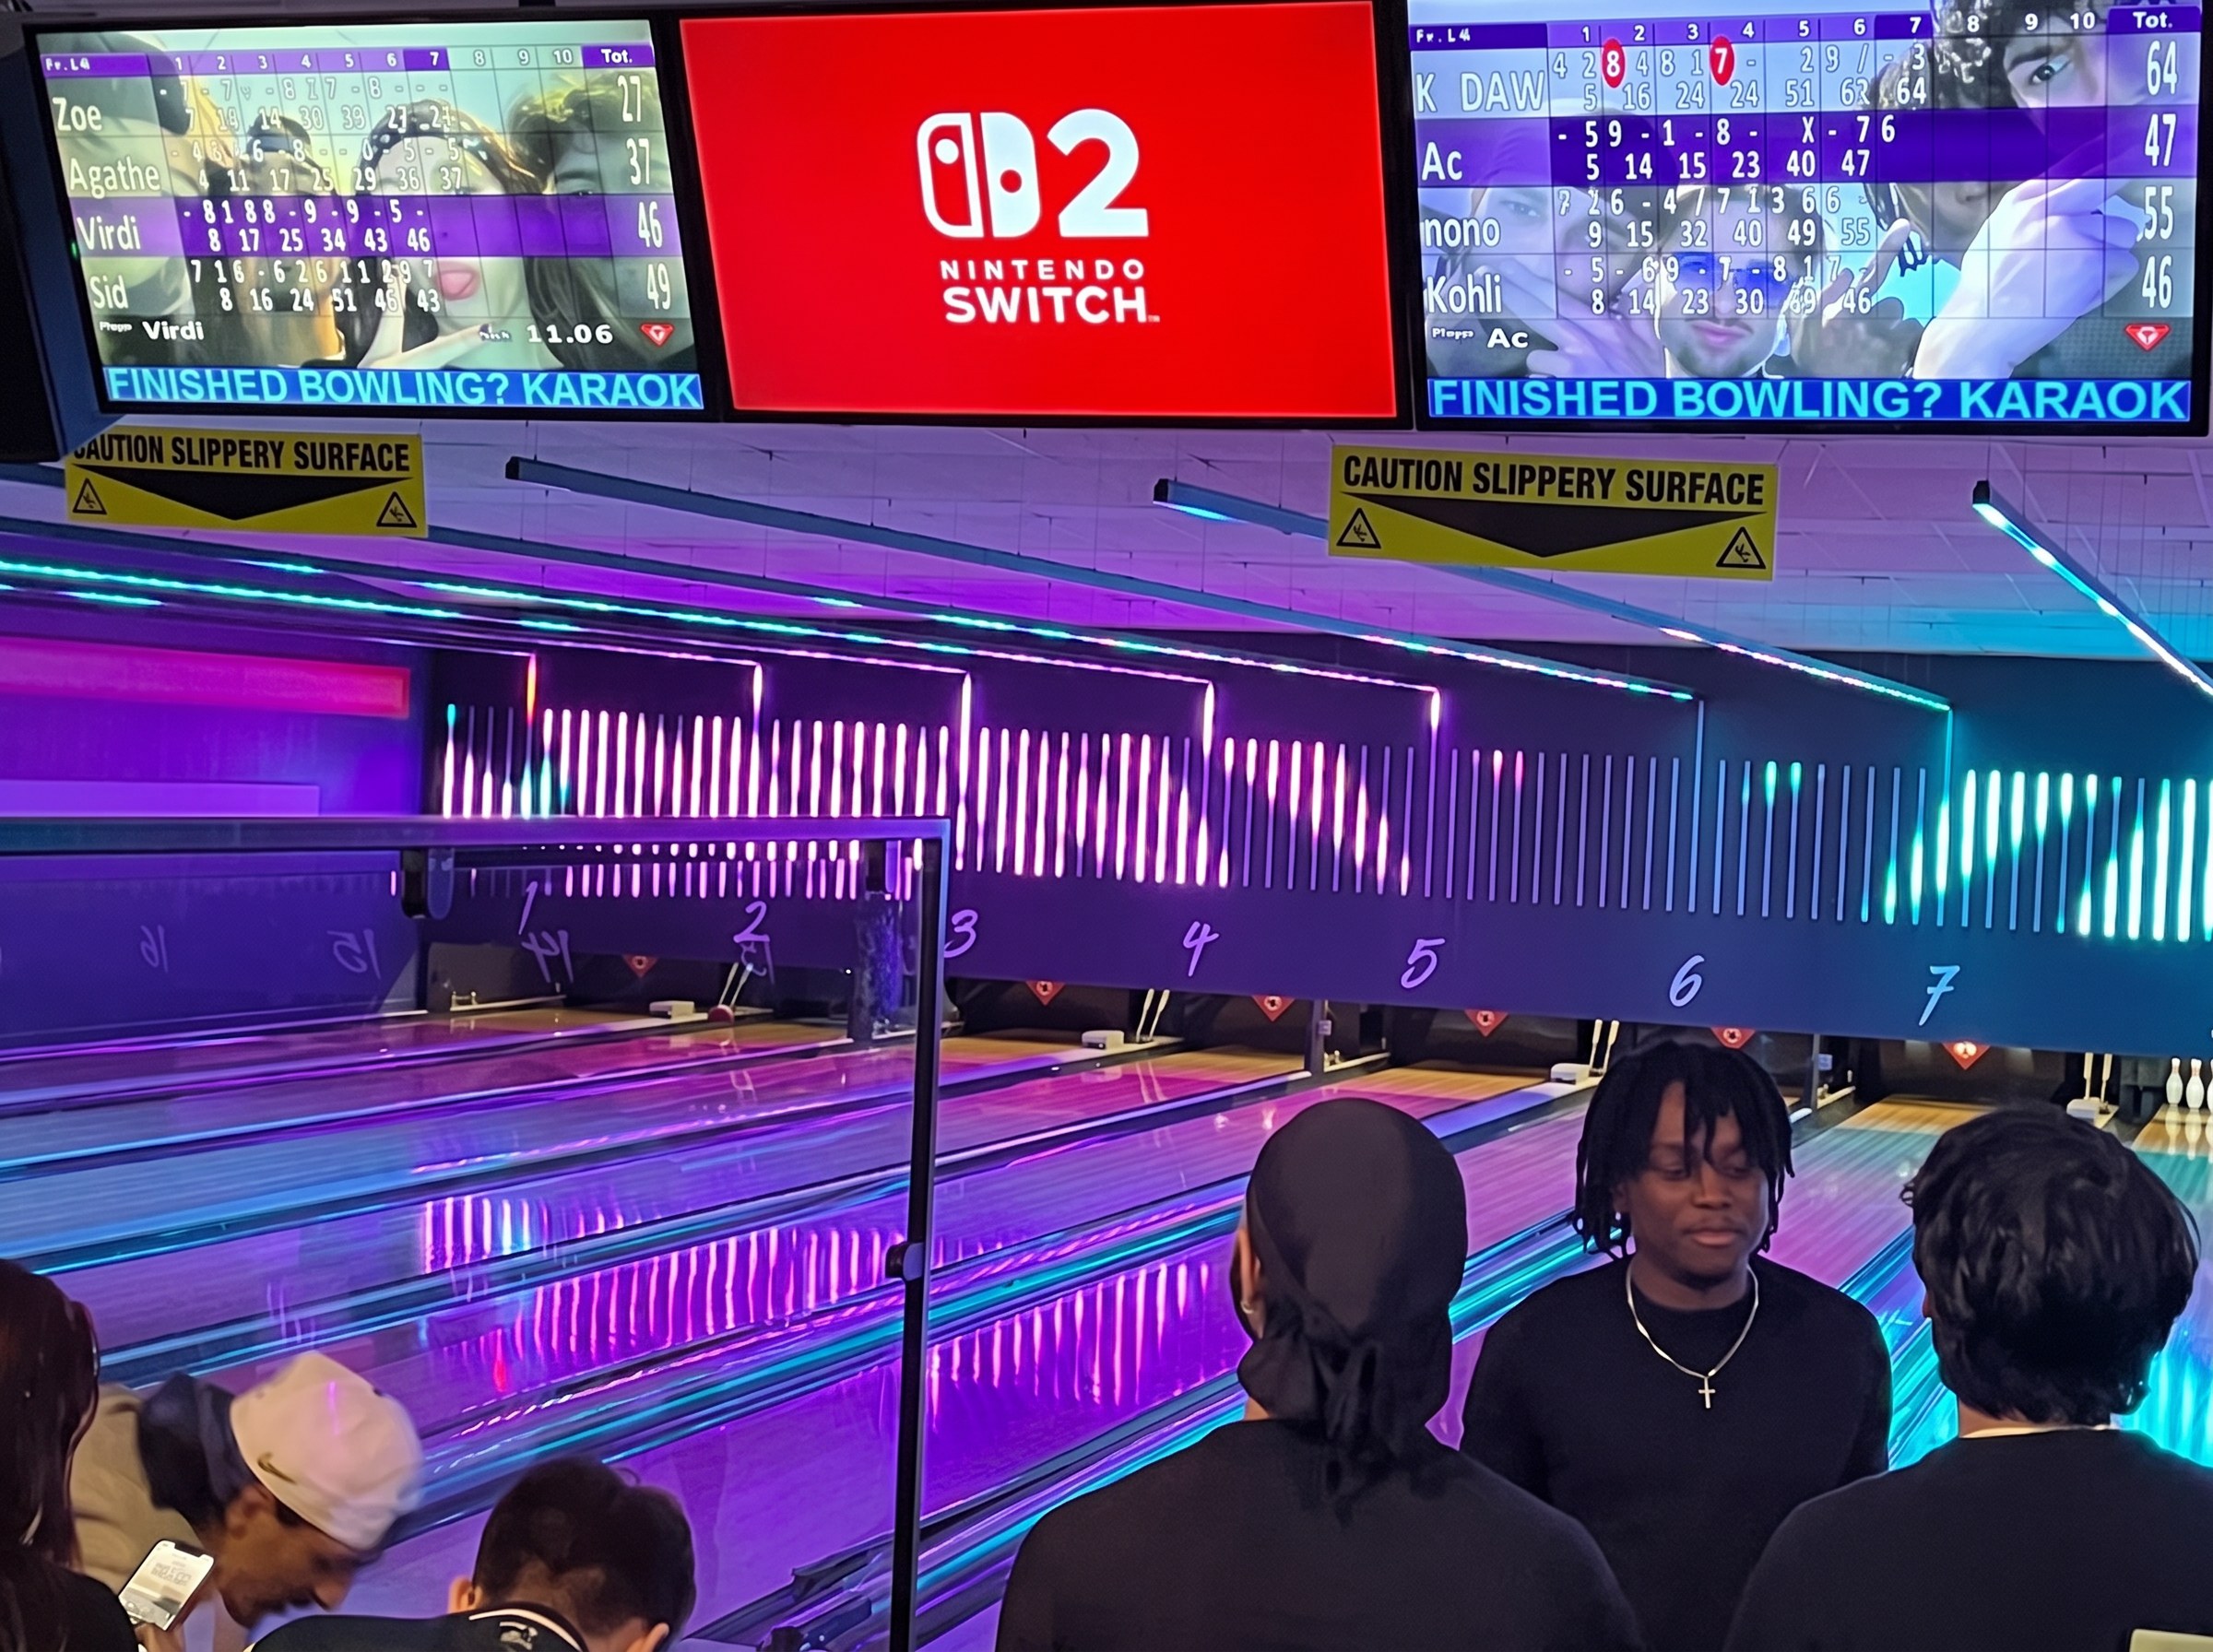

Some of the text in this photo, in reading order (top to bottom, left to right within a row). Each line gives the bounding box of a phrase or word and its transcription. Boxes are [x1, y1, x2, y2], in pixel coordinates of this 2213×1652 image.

[1582, 26, 1591, 42] 1
[1634, 25, 1645, 41] 2
[1687, 24, 1698, 40] 3
[1742, 22, 1755, 38] 4
[1799, 20, 1810, 37] 5
[1853, 18, 1865, 35] 6
[1910, 17, 1923, 33] 7
[1967, 15, 1980, 32] 8
[2025, 14, 2038, 30] 9
[2070, 12, 2096, 30] 10
[2133, 11, 2173, 29] Tot.
[175, 57, 183, 71] 1
[217, 56, 227, 70] 2
[258, 55, 268, 69] 3
[301, 54, 313, 68] 4
[345, 53, 355, 67] 5
[386, 53, 396, 66] 6
[430, 52, 439, 65] 7
[474, 51, 486, 65] 8
[518, 50, 530, 65] 9
[553, 49, 573, 64] 10
[601, 48, 633, 64] Tot.
[1553, 53, 1568, 77] 4
[1582, 52, 1596, 78] 2
[1606, 50, 1620, 77] 8
[1636, 51, 1649, 76] 4
[1661, 50, 1675, 76] 8
[1691, 49, 1703, 76] 1
[1714, 48, 1728, 74] 7
[1801, 46, 1814, 72] 2
[1911, 43, 1925, 70] 3
[2147, 41, 2178, 95] 64
[617, 75, 642, 122] 27
[1416, 71, 1545, 112] K DAW
[1584, 77, 1926, 111] 5 16 24 24 51 64
[53, 97, 103, 131] Zoe
[300, 107, 323, 129] 30
[342, 106, 365, 129] 39
[1585, 114, 1896, 148] 5 9 1 8 X 7 6
[2144, 113, 2177, 166] 47
[69, 158, 160, 200] Agathe
[199, 167, 462, 192] 4 11 17 25 29 36 37
[626, 137, 650, 185] 37
[1047, 108, 1149, 238] 2
[1422, 142, 1463, 181] Ac
[1586, 149, 1871, 181] 5 14 15 23 40 47
[203, 199, 402, 224] 8 1 8 8 9 9 5
[1610, 188, 1625, 215] 6
[1663, 188, 1677, 214] 4
[1717, 187, 1731, 214] 7
[1771, 186, 1785, 214] 3
[1802, 186, 1817, 213] 6
[1826, 186, 1840, 213] 6
[2144, 185, 2174, 240] 55
[76, 215, 141, 251] Virdi
[208, 228, 431, 253] 8 17 25 34 43 46
[638, 201, 663, 248] 46
[1423, 218, 1501, 248] nono
[1589, 218, 1871, 248] 9 15 32 40 49 55
[647, 263, 671, 310] 49
[940, 258, 1144, 280] NINTENDO
[2142, 255, 2173, 308] 46
[91, 275, 129, 310] Sid
[219, 287, 232, 312] 8
[250, 288, 273, 312] 16
[290, 288, 314, 312] 24
[417, 289, 441, 313] 43
[942, 285, 1147, 324] SWITCH
[1426, 274, 1503, 313] Kohli
[1592, 289, 1605, 314] 8
[1629, 289, 1655, 314] 14
[1682, 289, 1710, 314] 23
[1735, 289, 1764, 314] 30
[1842, 288, 1872, 314] 46
[142, 321, 205, 341] Virdi
[527, 324, 614, 344] 11.06
[1486, 327, 1530, 348] Ac
[108, 368, 701, 407] FINISHED BOWLING? KARAOK
[1433, 379, 2188, 419] FINISHED BOWLING? KARAOK
[172, 436, 284, 468] SLIPPERY
[294, 442, 410, 472] SURFACE
[1343, 455, 1765, 505] CAUTION SLIPPERY SURFACE
[518, 880, 538, 935] 1
[733, 900, 771, 943] 2
[943, 909, 979, 959] 3
[1183, 921, 1219, 977] 4
[1401, 938, 1446, 989] 5
[1670, 954, 1705, 1008] 6
[1918, 964, 1961, 1026] 7
